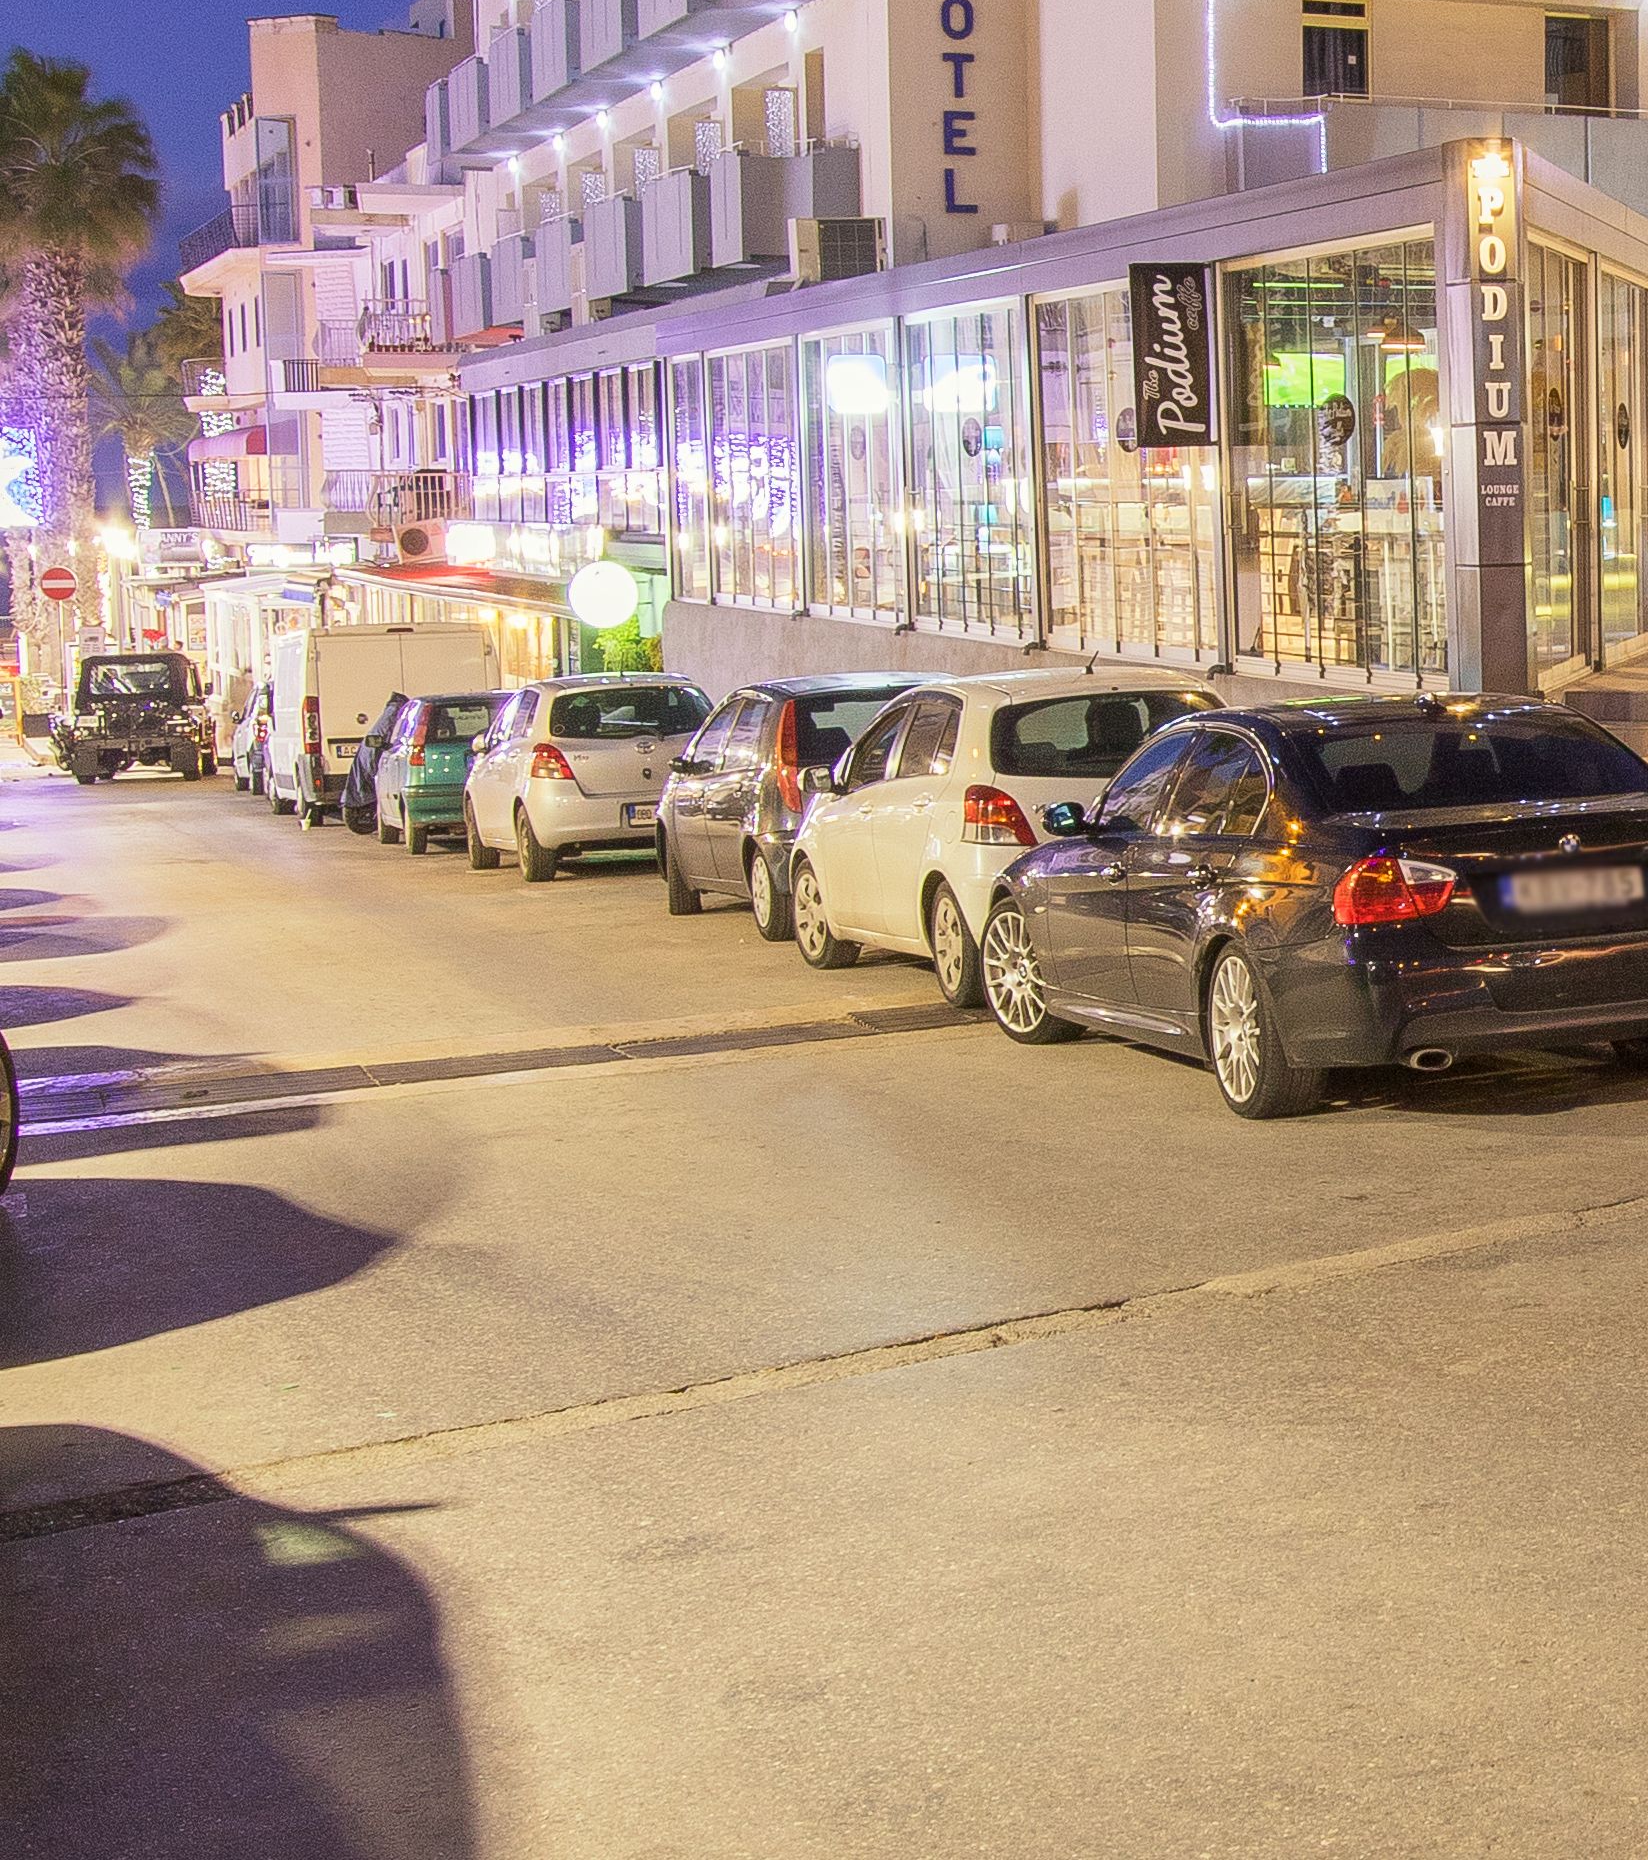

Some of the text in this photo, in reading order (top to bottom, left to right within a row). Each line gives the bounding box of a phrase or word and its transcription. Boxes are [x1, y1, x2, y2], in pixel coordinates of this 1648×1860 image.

[1477, 187, 1517, 467] PODIUM
[1144, 274, 1206, 435] Podium
[1142, 371, 1160, 401] The
[1481, 484, 1519, 495] LOUNGE
[1485, 496, 1516, 507] CAFFE
